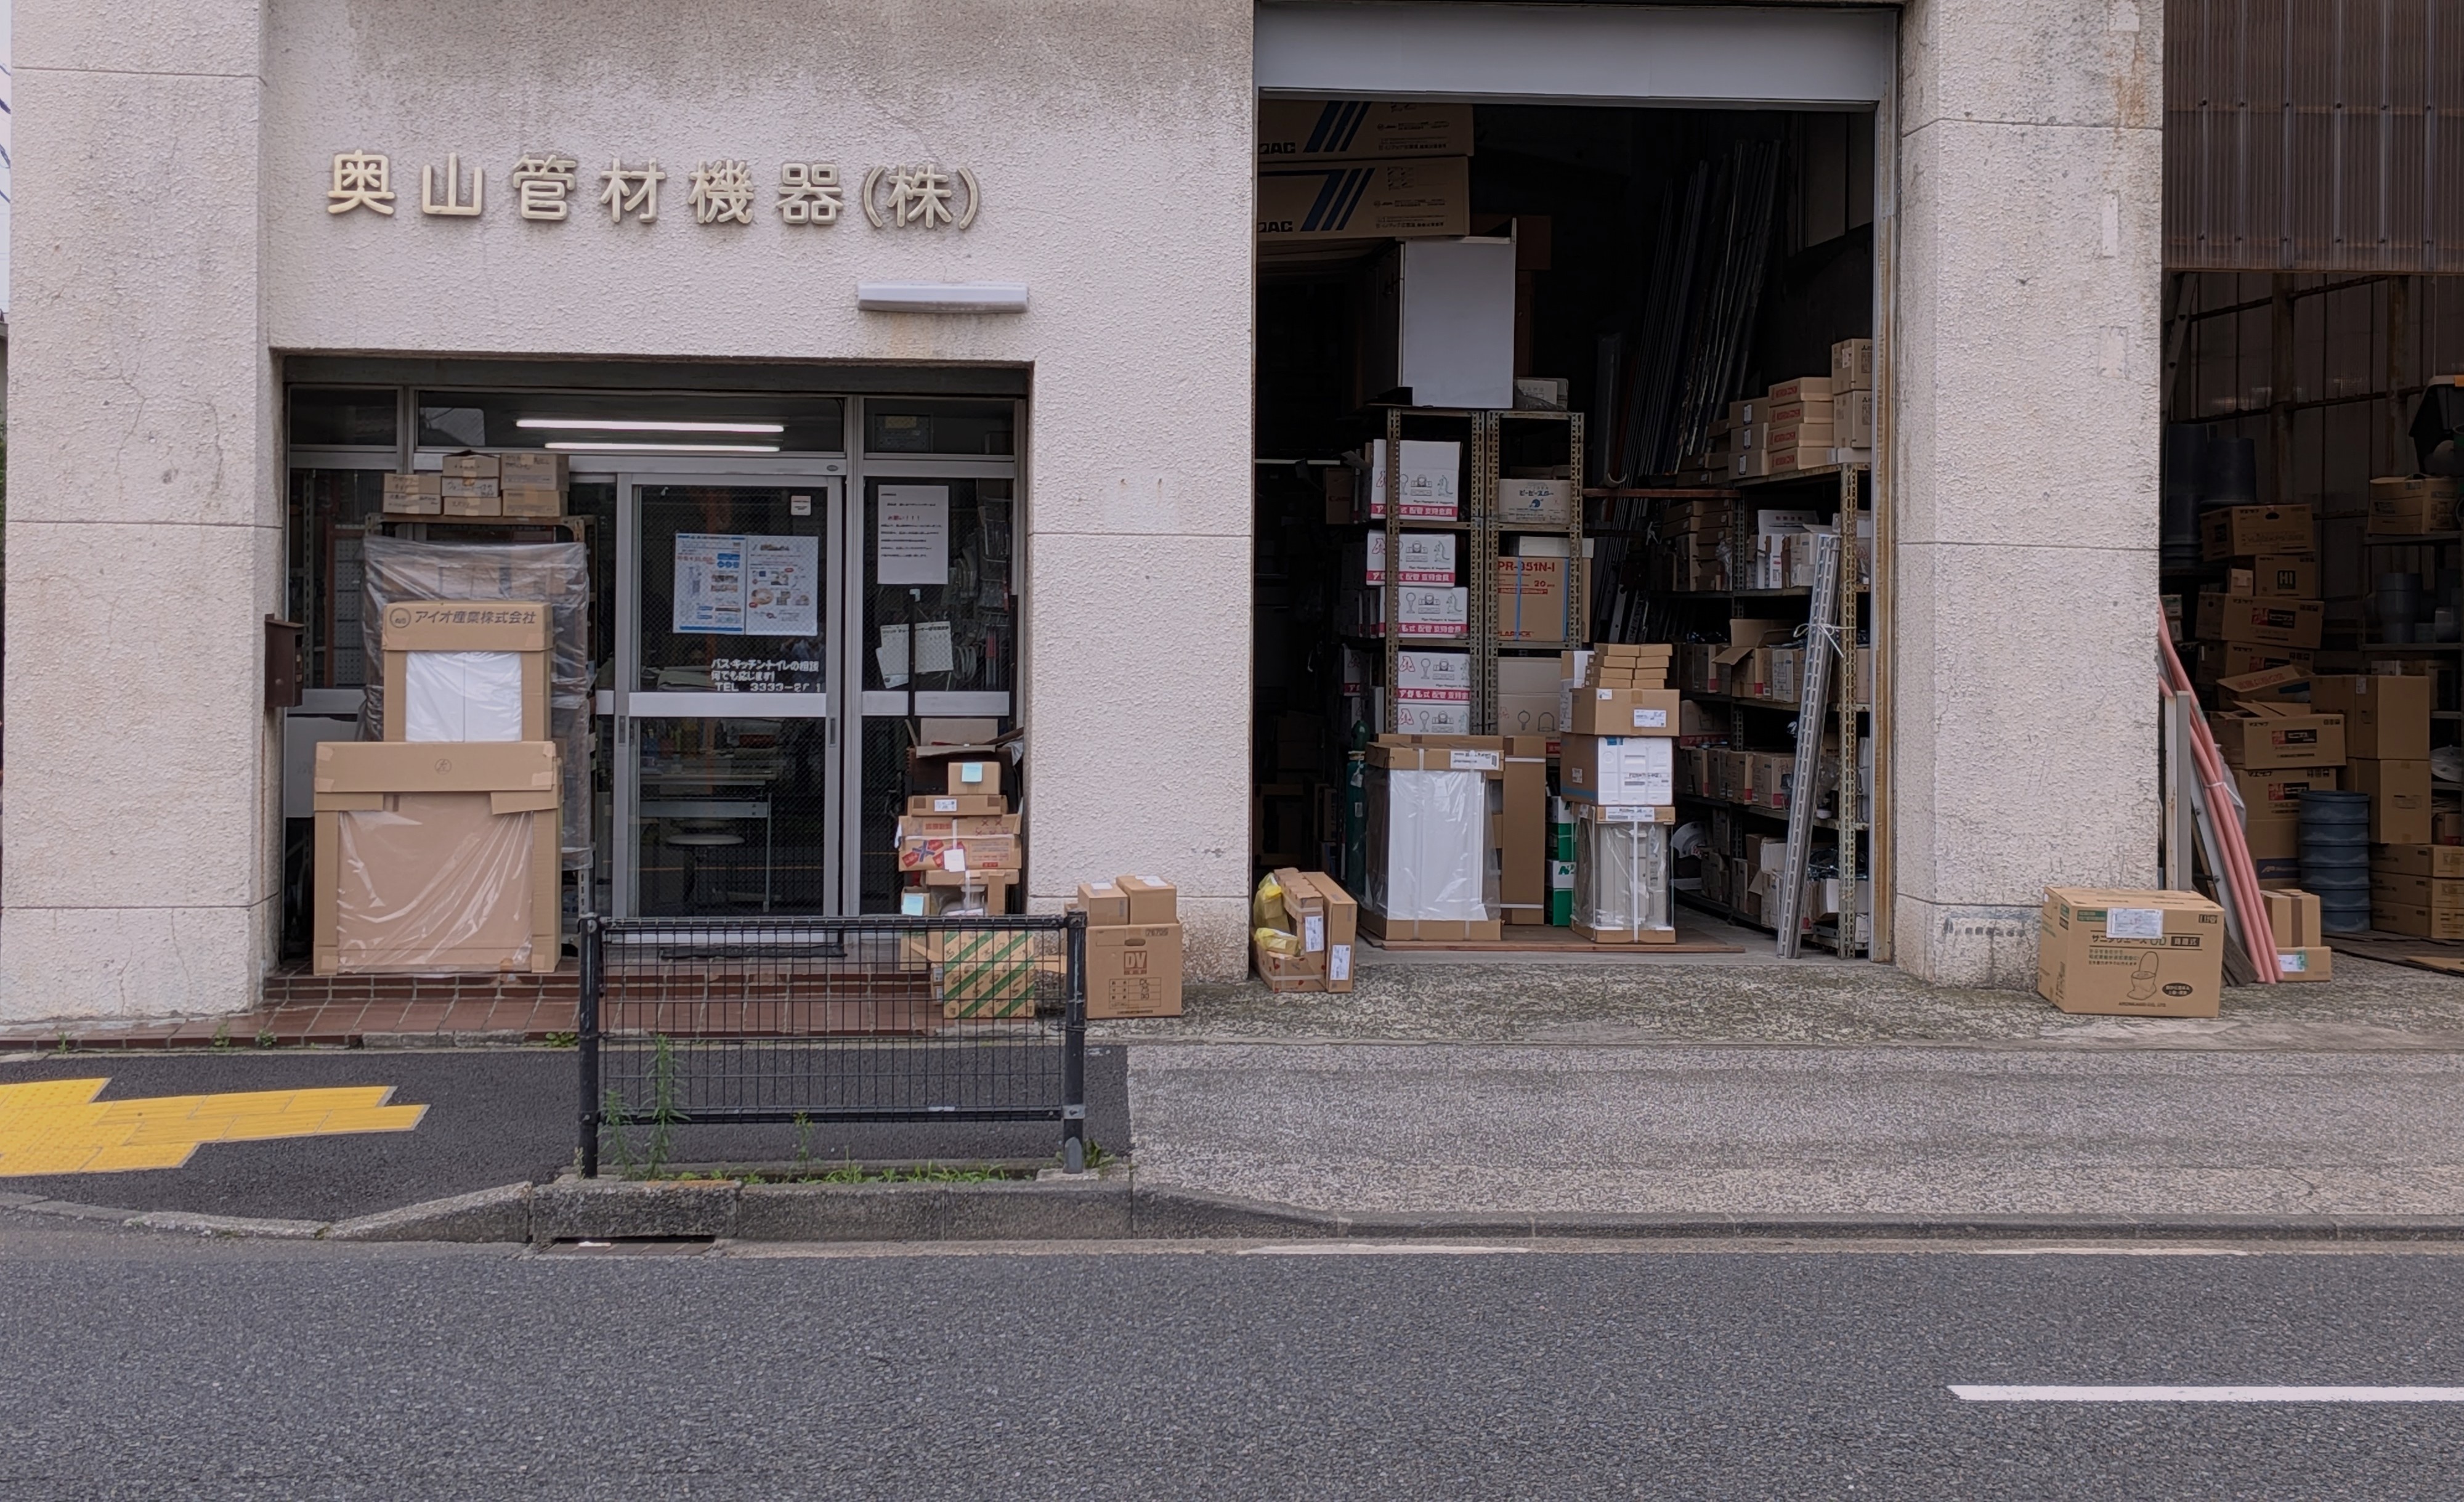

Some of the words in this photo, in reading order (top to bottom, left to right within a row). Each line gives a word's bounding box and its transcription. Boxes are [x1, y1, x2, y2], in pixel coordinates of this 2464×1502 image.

[326, 148, 981, 230] 奥山管材機器(株)
[2279, 572, 2293, 585] HI
[715, 682, 739, 691] TEL
[1125, 952, 1146, 968] DV
